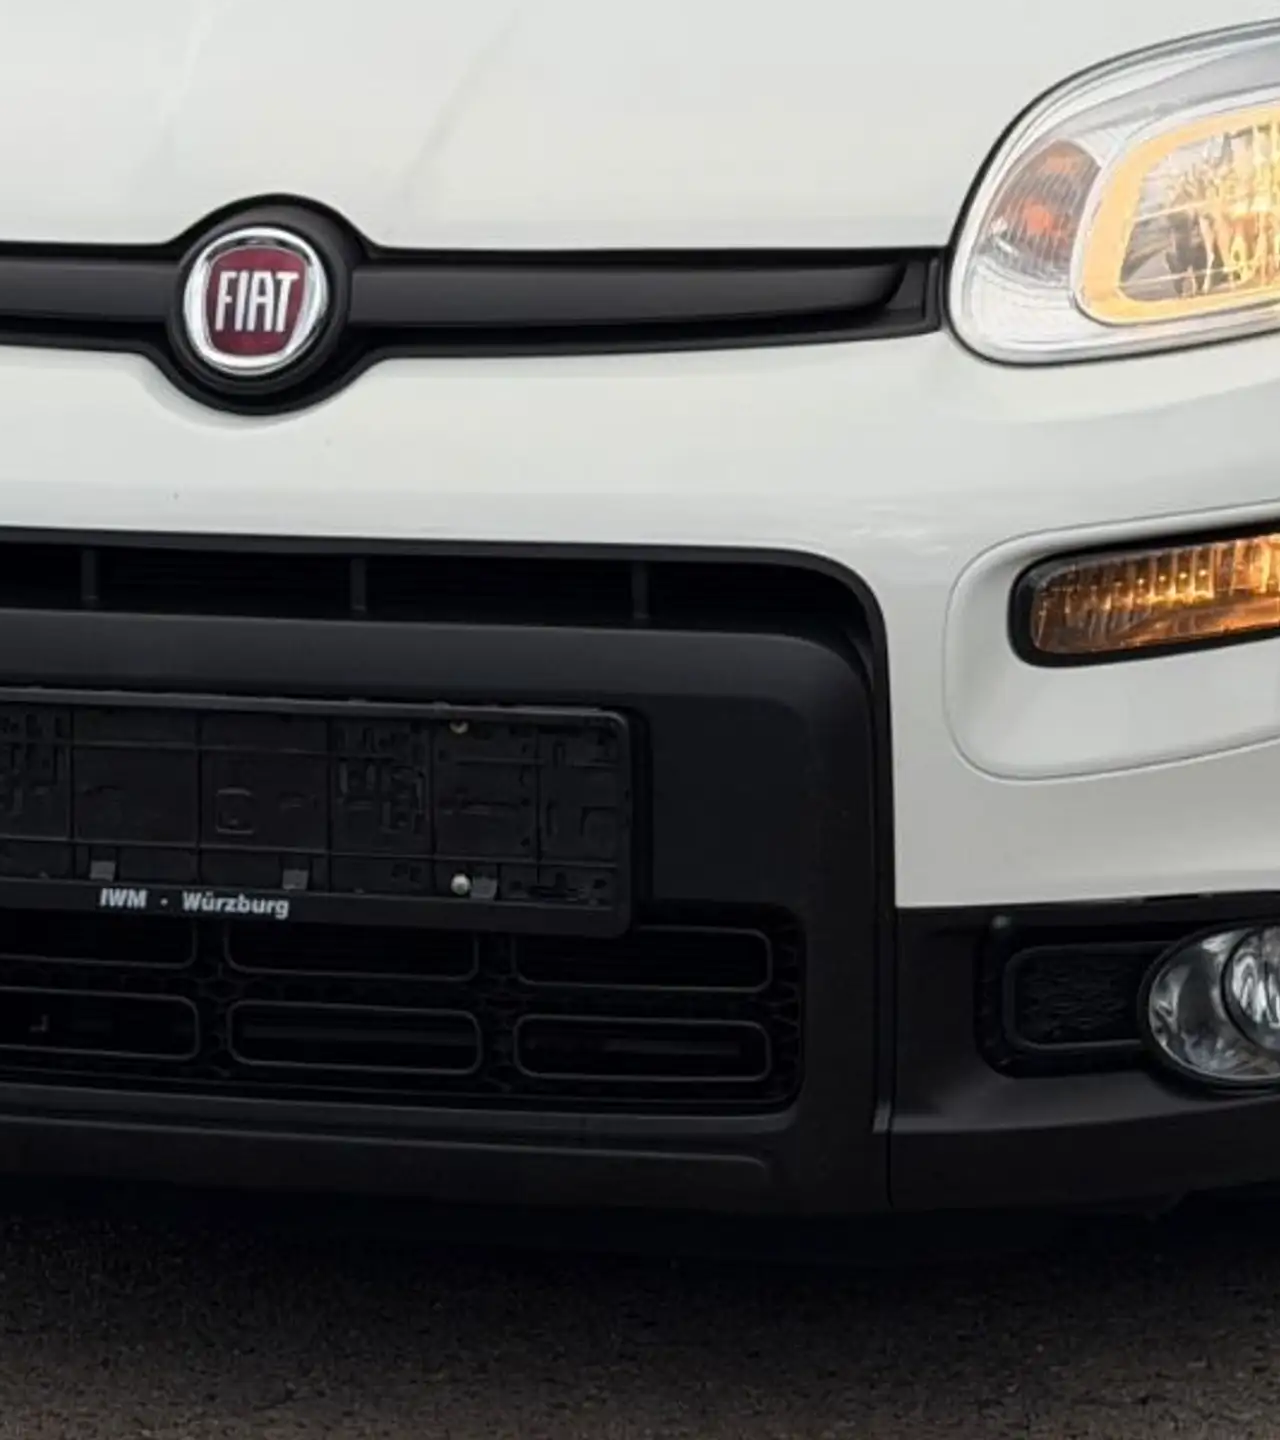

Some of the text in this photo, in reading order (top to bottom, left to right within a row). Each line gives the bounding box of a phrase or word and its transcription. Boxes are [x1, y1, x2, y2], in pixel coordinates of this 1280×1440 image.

[215, 270, 299, 332] FIAT
[100, 888, 148, 908] IWM
[182, 890, 290, 920] Würzburg
